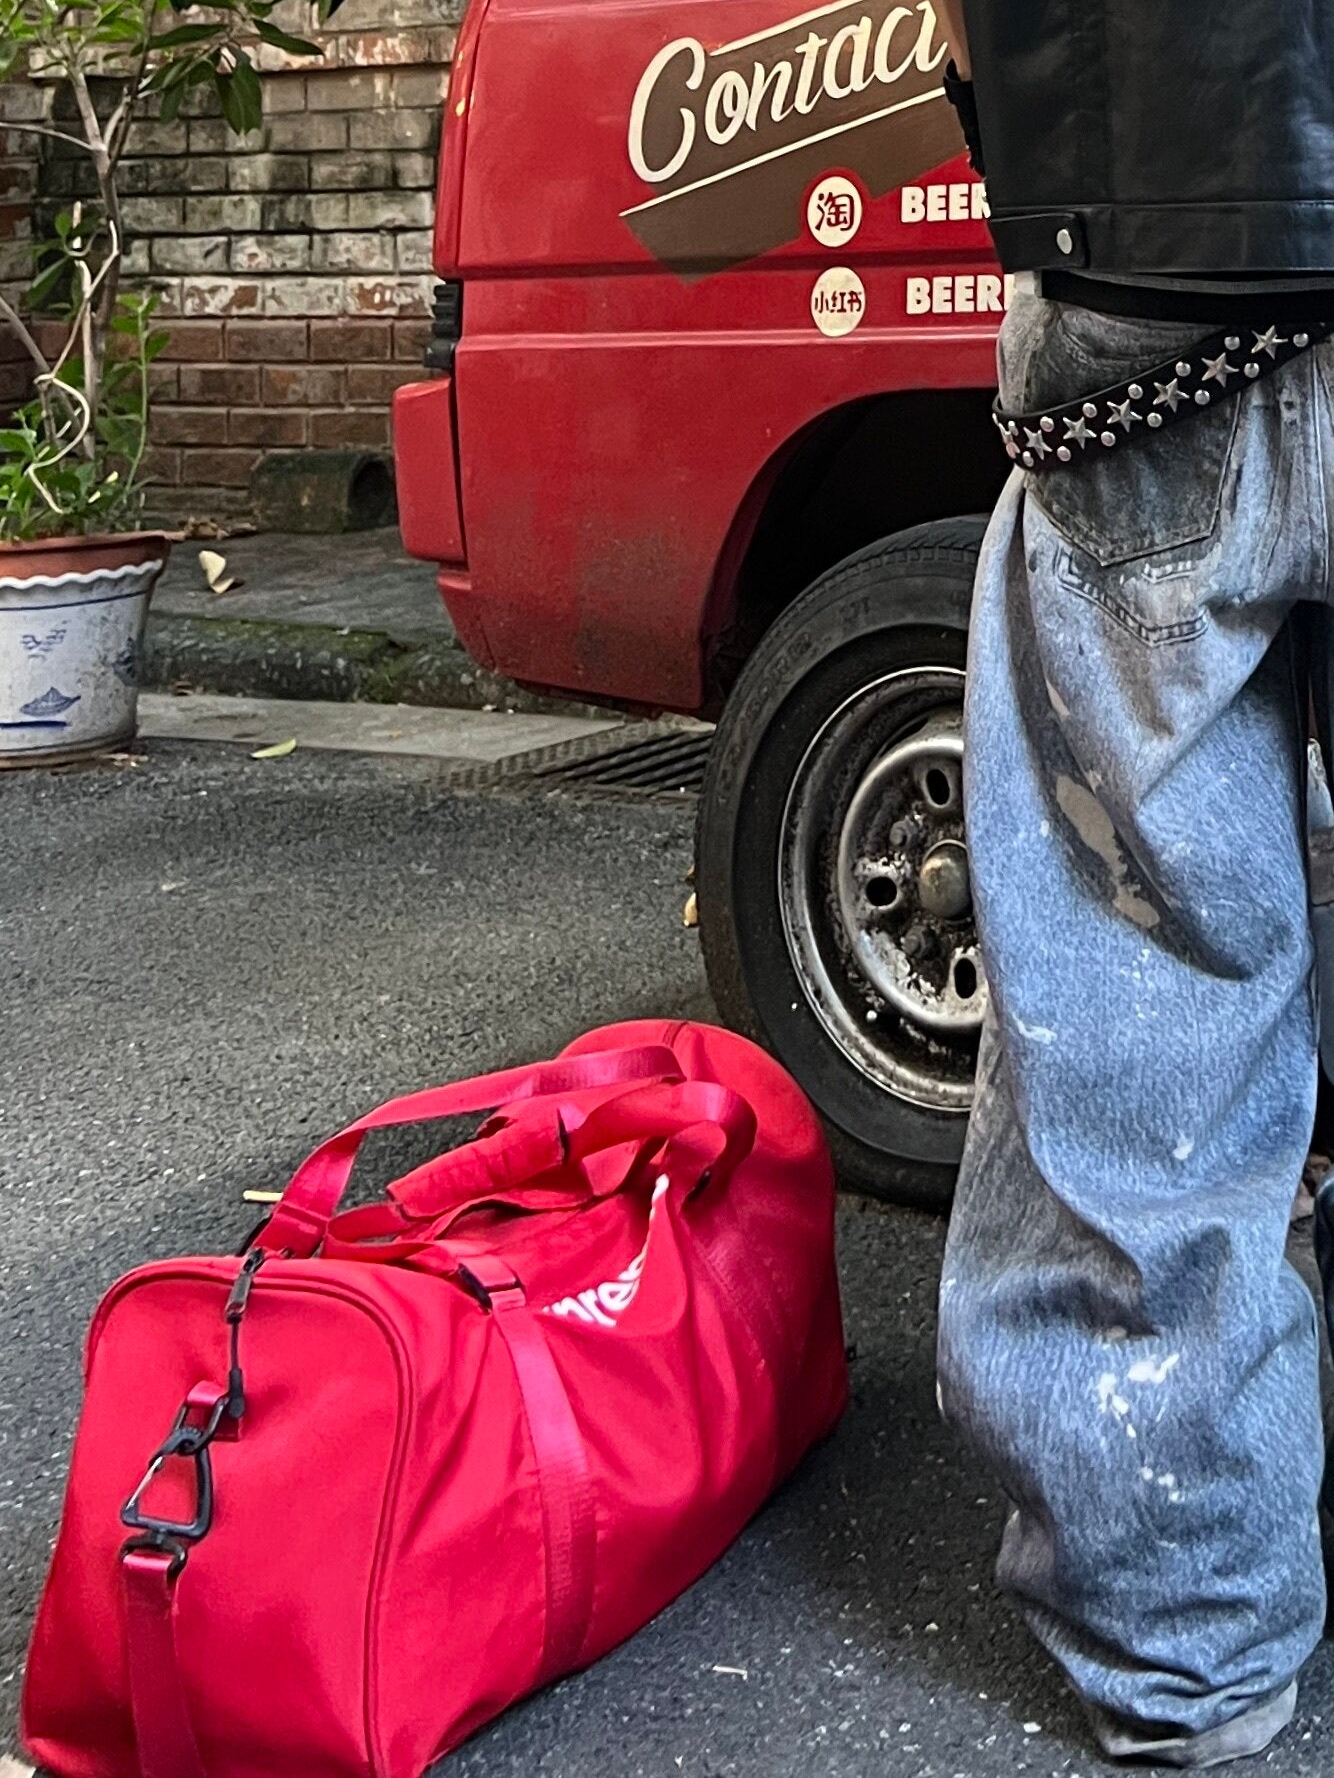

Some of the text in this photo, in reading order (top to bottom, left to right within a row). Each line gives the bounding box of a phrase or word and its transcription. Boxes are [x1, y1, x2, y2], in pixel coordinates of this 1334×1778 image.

[627, 0, 948, 183] Contact
[814, 191, 855, 232] 淘
[813, 289, 863, 315] 小红书
